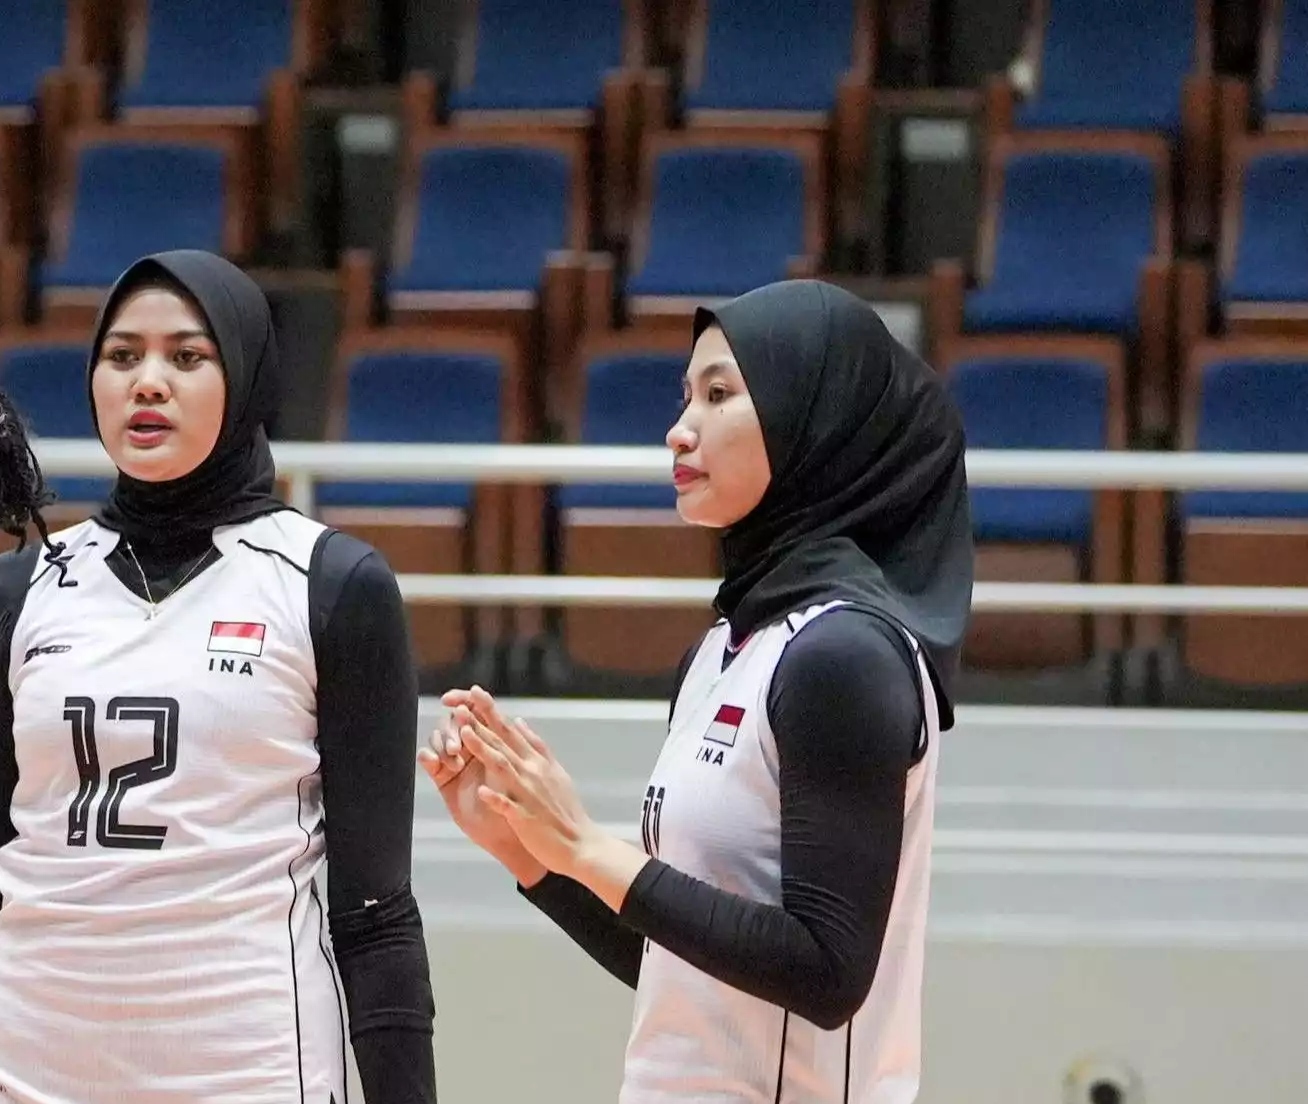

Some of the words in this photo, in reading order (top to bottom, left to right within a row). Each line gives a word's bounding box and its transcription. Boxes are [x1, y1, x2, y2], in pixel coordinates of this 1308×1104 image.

[208, 657, 255, 677] INA
[696, 745, 726, 766] INA
[62, 696, 180, 850] 12
